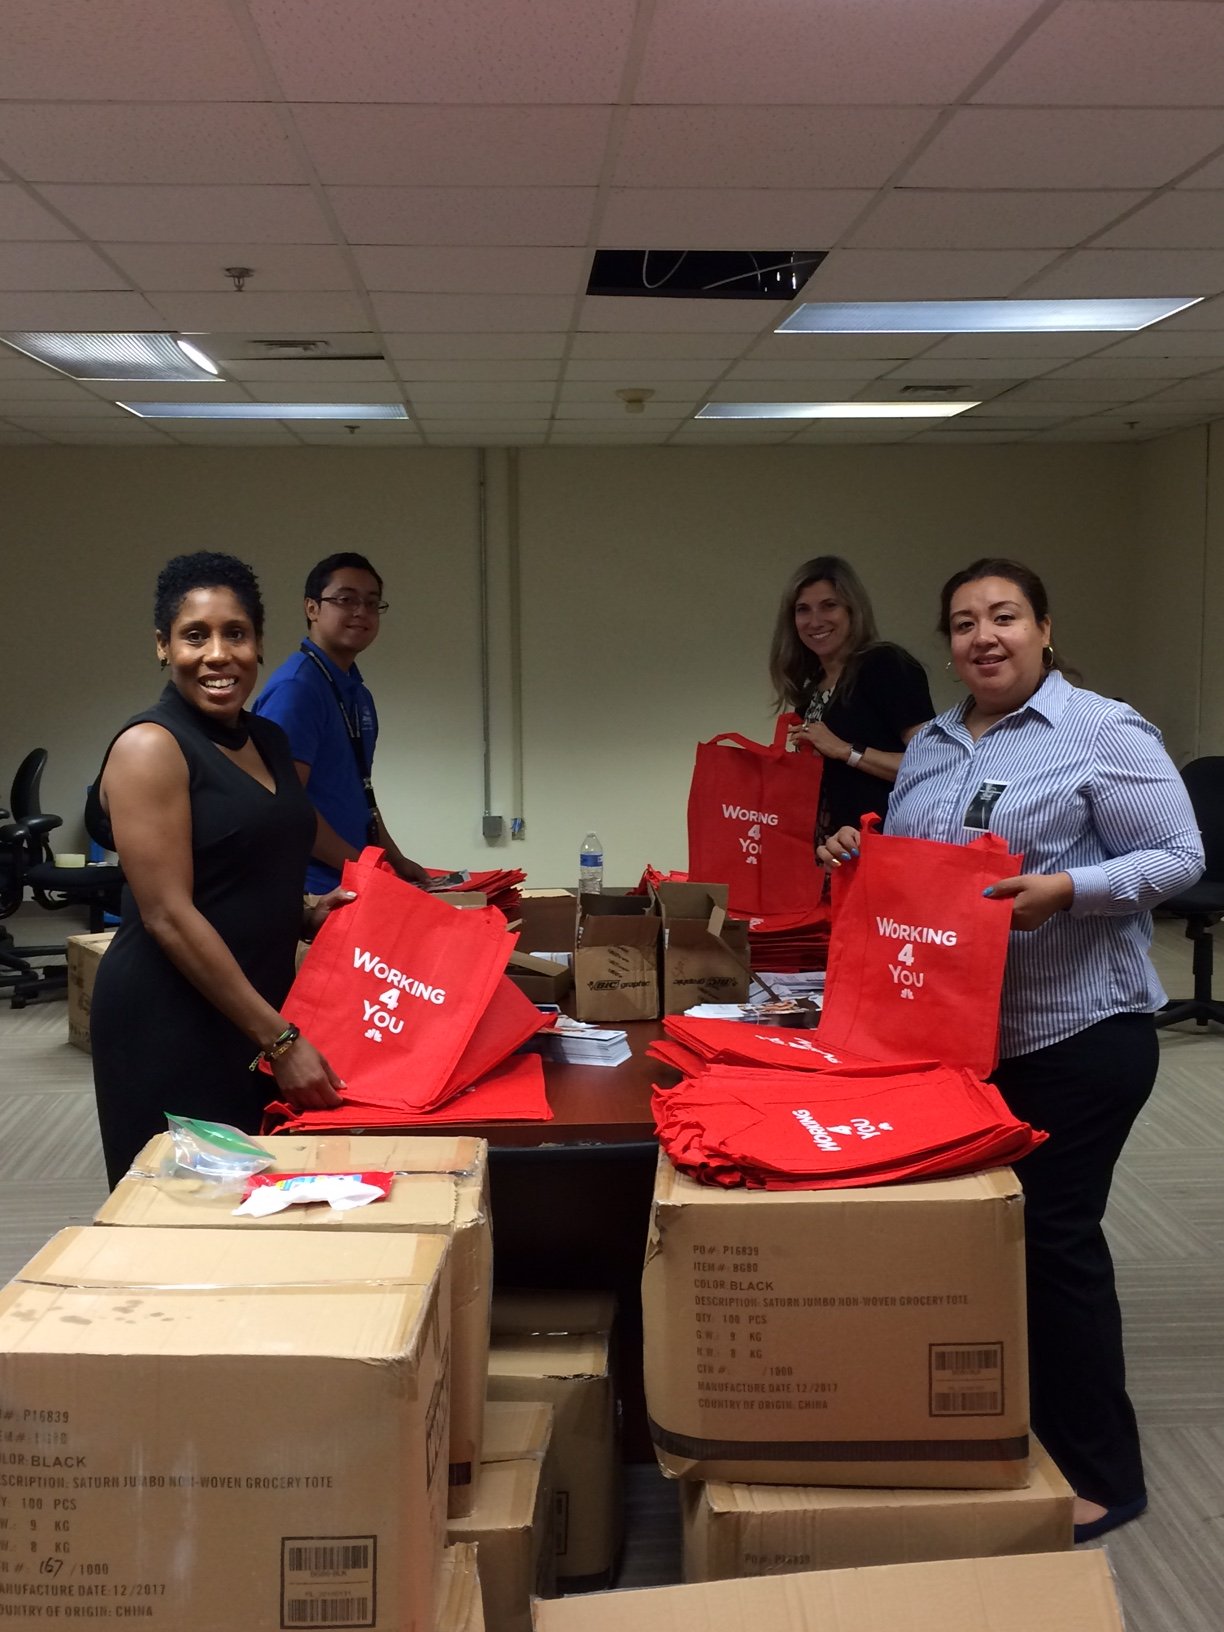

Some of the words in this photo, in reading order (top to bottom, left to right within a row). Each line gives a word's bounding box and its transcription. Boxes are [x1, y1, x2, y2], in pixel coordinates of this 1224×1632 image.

[748, 824, 761, 841] 4
[738, 838, 762, 855] YO
[876, 916, 957, 947] WORKING
[898, 943, 915, 967] 4
[353, 947, 446, 1005] WORKING
[888, 964, 924, 988] YOU
[594, 979, 620, 991] BIC
[379, 987, 401, 1011] 4
[362, 999, 404, 1034] YOU
[792, 1109, 842, 1152] WORKING
[826, 1125, 853, 1136] 4
[850, 1118, 881, 1140] YOU
[723, 1245, 759, 1256] P16839
[730, 1280, 775, 1292] BLACK
[763, 1297, 800, 1308] SATURN
[803, 1297, 835, 1307] JUMBO
[838, 1296, 897, 1307] NON-WOVEN
[900, 1295, 944, 1306] GROCERY
[946, 1294, 969, 1305] TOTE
[723, 1314, 740, 1324] 100
[748, 1315, 768, 1325] PCS
[730, 1332, 736, 1342] 9
[750, 1332, 762, 1342] KG
[750, 1349, 763, 1359] KG
[698, 1381, 766, 1393] MANUFACTURE
[698, 1398, 741, 1409] COUNTRY
[743, 1399, 755, 1409] OF
[798, 1399, 828, 1410] CHINA
[23, 1409, 69, 1423] P16839
[0, 1452, 28, 1465] LOR:
[30, 1455, 87, 1468] BLACK
[0, 1474, 70, 1489] SCRIPTION:
[73, 1476, 120, 1489] SATURN
[245, 1476, 301, 1489] GROCERY
[305, 1476, 333, 1489] TOTE
[22, 1497, 43, 1510] 100
[53, 1498, 77, 1511] PCS
[30, 1519, 37, 1531] 9
[54, 1519, 71, 1532] KG
[30, 1540, 37, 1553] 8
[54, 1541, 71, 1553] KG
[39, 1557, 64, 1578] 167
[46, 1605, 61, 1617] OF
[64, 1605, 112, 1618] ORIGIN:
[115, 1605, 154, 1618] CHINA
